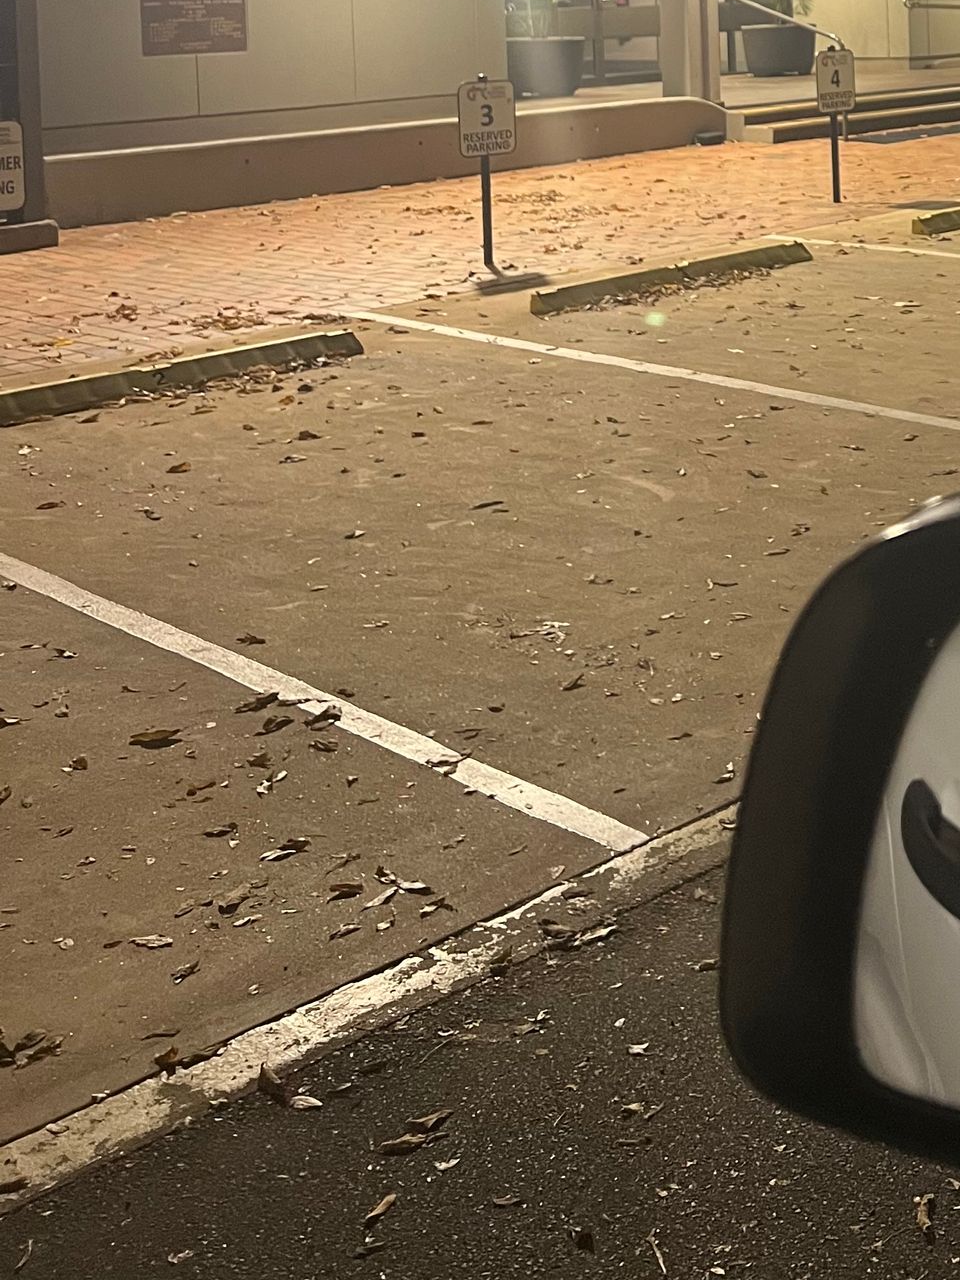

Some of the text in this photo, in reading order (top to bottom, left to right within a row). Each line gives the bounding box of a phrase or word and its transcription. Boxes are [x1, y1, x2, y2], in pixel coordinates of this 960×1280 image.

[831, 69, 841, 88] 4
[480, 104, 494, 127] 3
[463, 129, 513, 144] RESERVED
[466, 140, 512, 154] PARKING
